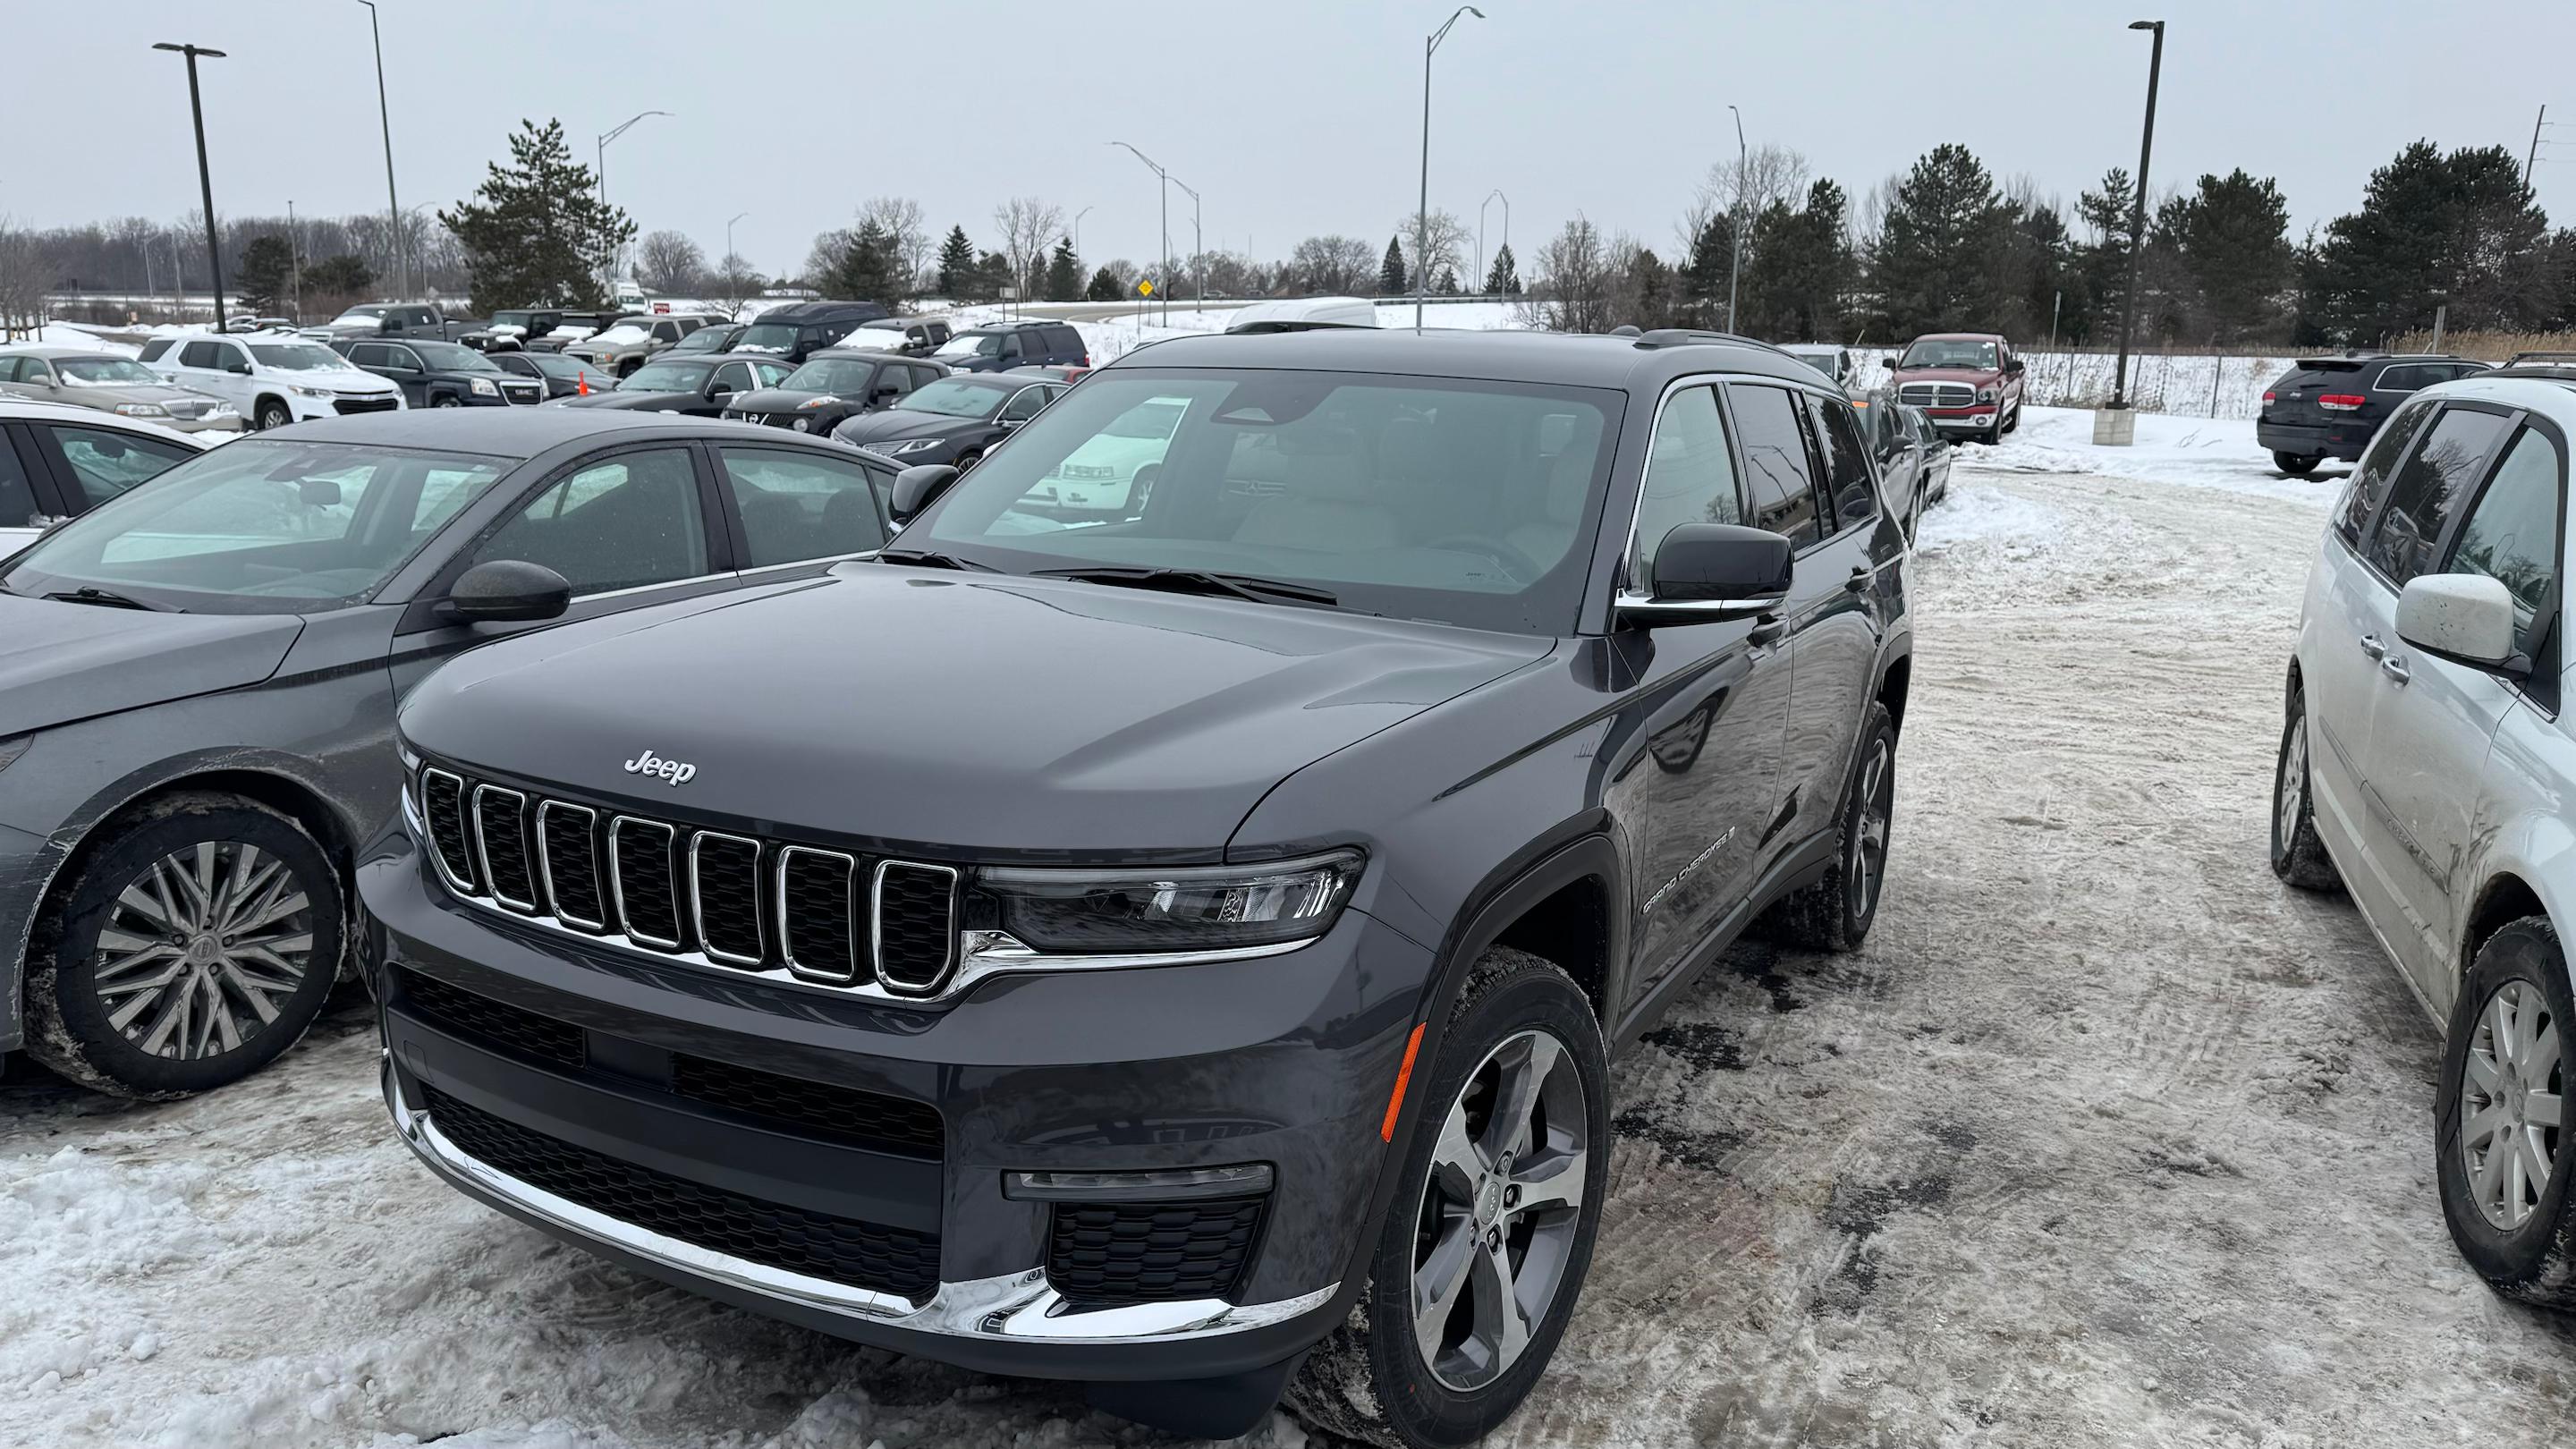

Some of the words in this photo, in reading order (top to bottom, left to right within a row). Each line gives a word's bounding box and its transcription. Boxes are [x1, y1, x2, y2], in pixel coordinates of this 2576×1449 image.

[624, 750, 697, 786] Jeep
[1642, 877, 1677, 914] GRAND
[1679, 833, 1728, 880] CHEROKEE
